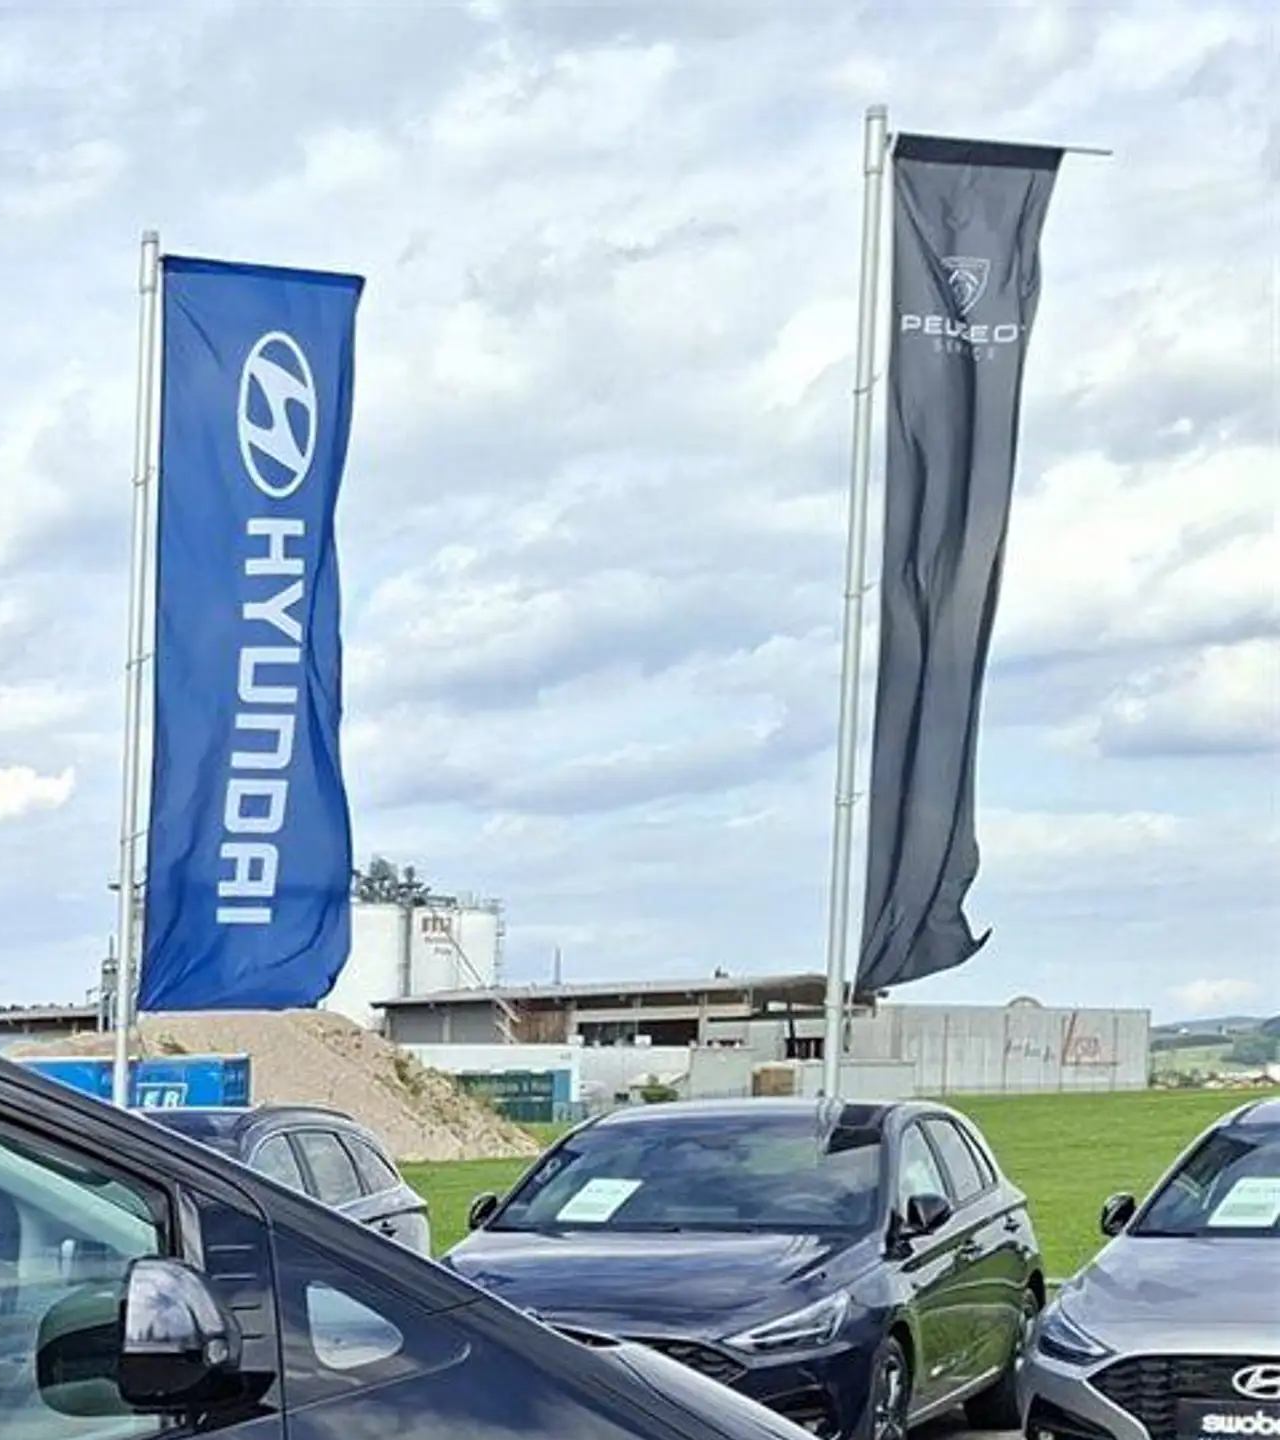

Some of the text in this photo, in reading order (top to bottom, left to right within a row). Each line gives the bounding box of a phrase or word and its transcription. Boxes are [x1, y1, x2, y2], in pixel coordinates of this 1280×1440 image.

[901, 314, 1026, 343] PEUEO
[216, 518, 305, 924] HYUNDAI
[1202, 1410, 1280, 1435] swob
